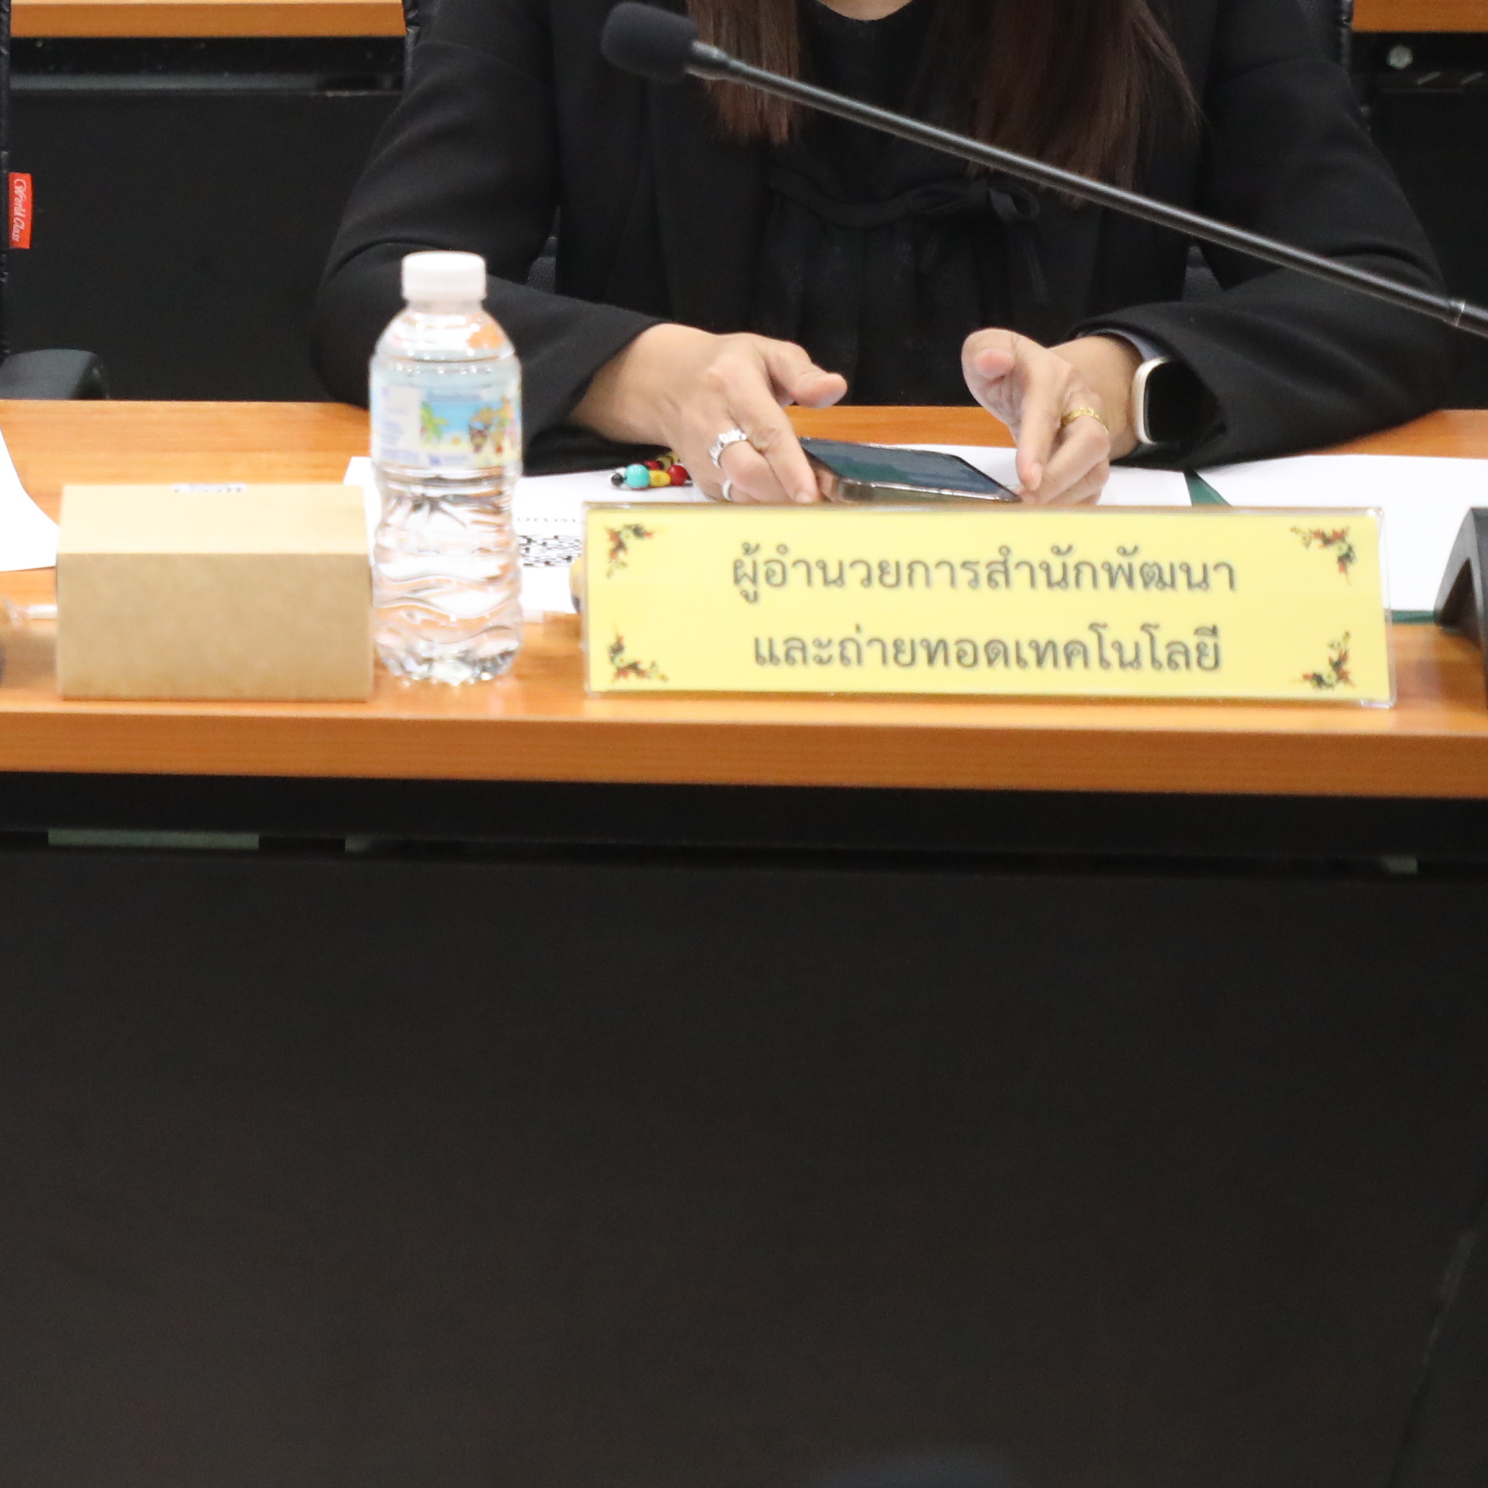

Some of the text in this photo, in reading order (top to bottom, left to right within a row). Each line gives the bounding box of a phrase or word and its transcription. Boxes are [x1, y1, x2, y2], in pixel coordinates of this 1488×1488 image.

[731, 541, 1237, 604] ผู้อำนวยการสำนักพัฒนา
[753, 622, 1223, 673] และถ่ายทอดเทคโนโลยี
